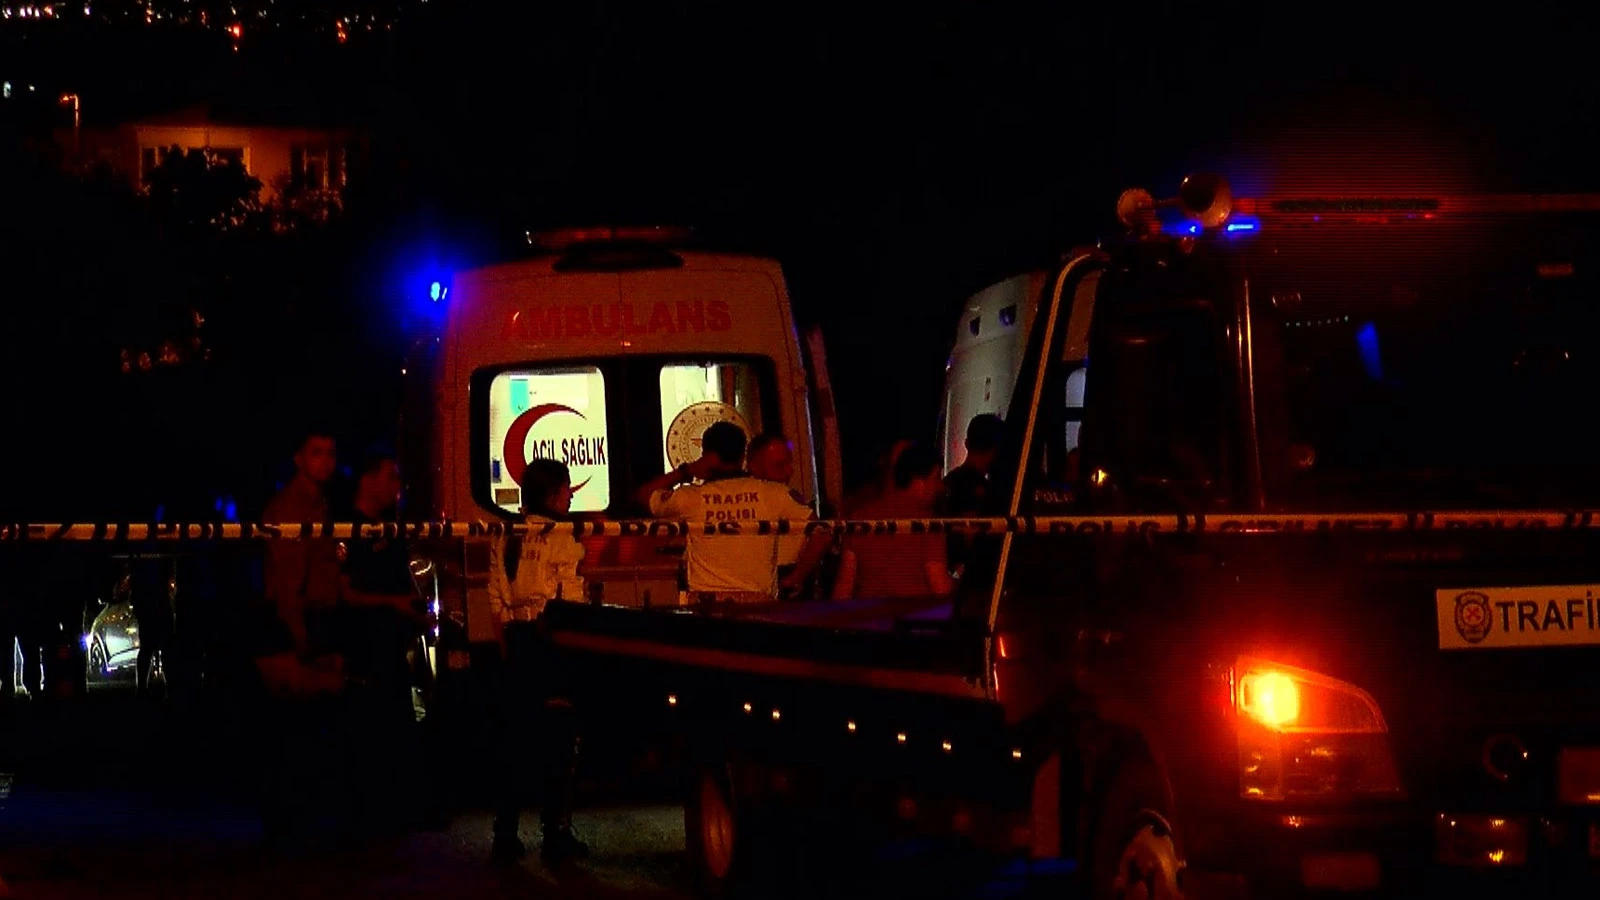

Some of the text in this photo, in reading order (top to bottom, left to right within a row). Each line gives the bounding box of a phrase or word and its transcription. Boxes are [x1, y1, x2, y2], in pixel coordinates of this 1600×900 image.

[501, 300, 732, 340] AMBULANS
[561, 434, 606, 467] SAĞLIK
[1496, 590, 1600, 632] TRAFİ
